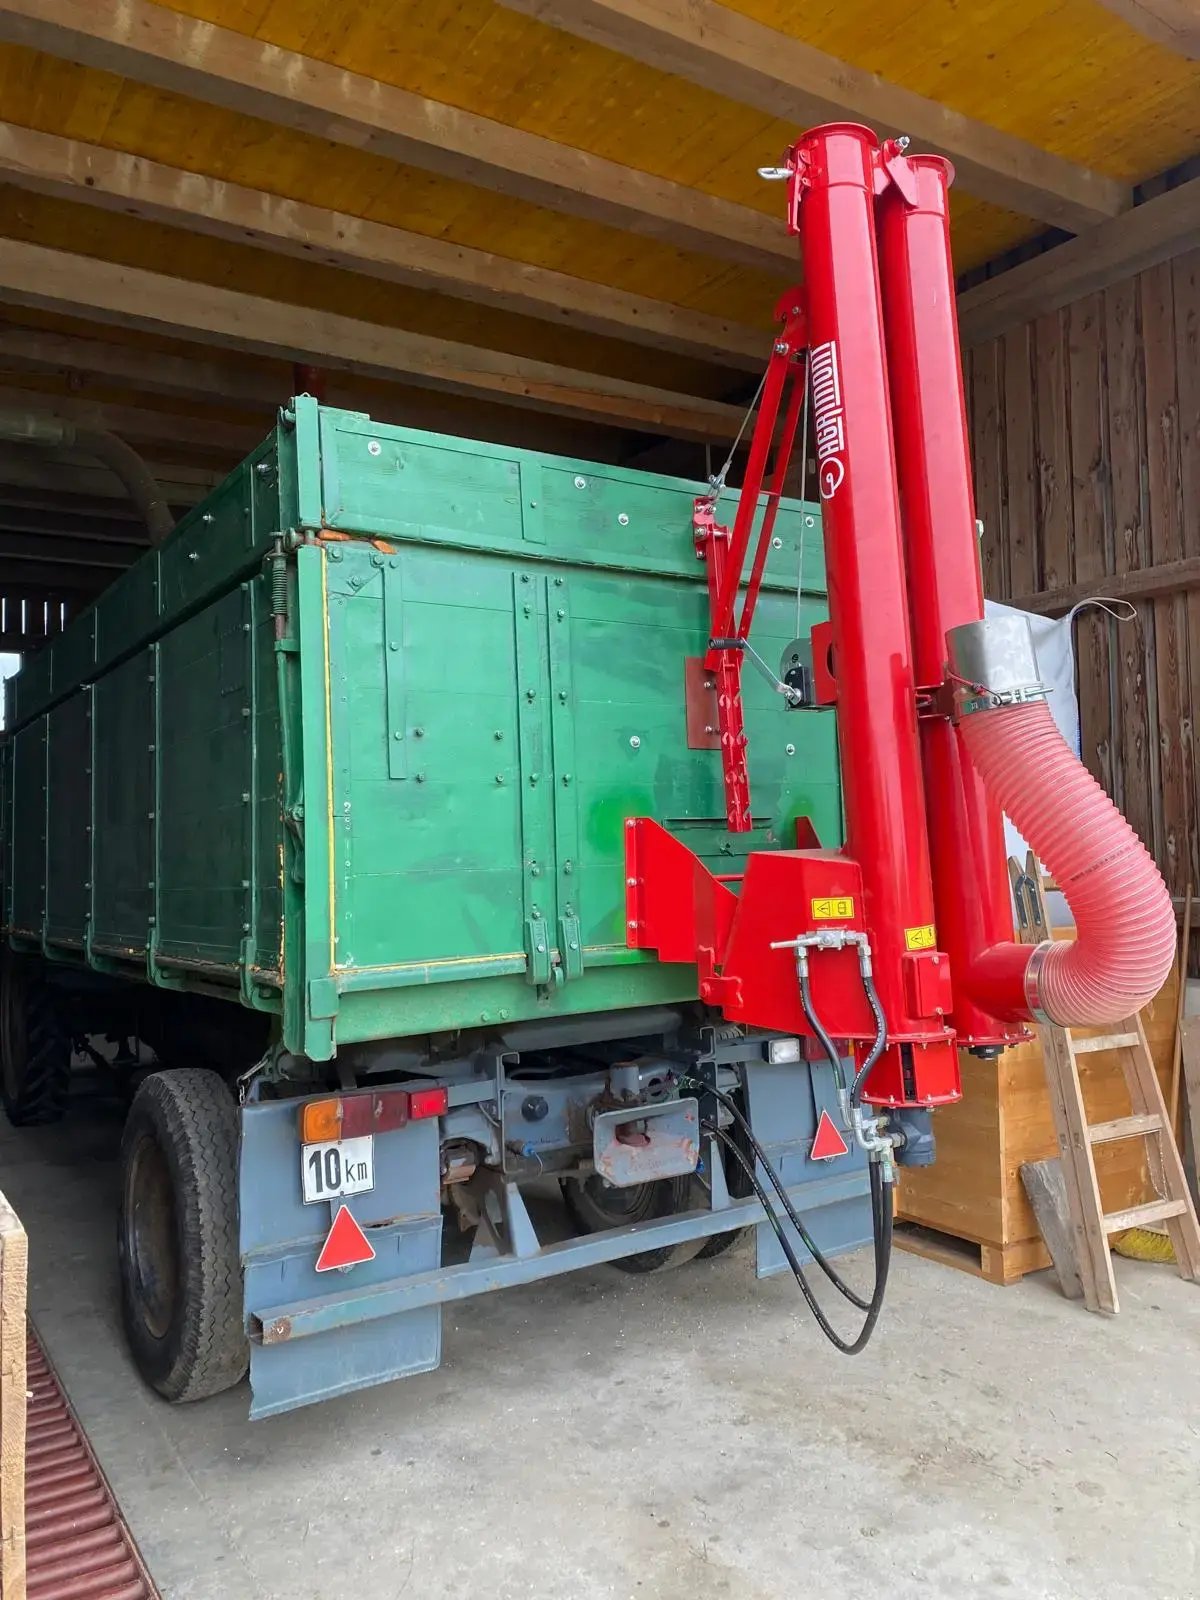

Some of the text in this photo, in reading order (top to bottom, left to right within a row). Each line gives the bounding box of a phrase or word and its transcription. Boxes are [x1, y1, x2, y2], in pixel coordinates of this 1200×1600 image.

[810, 341, 843, 460] AGRIMONT
[309, 1148, 368, 1193] 10 km
